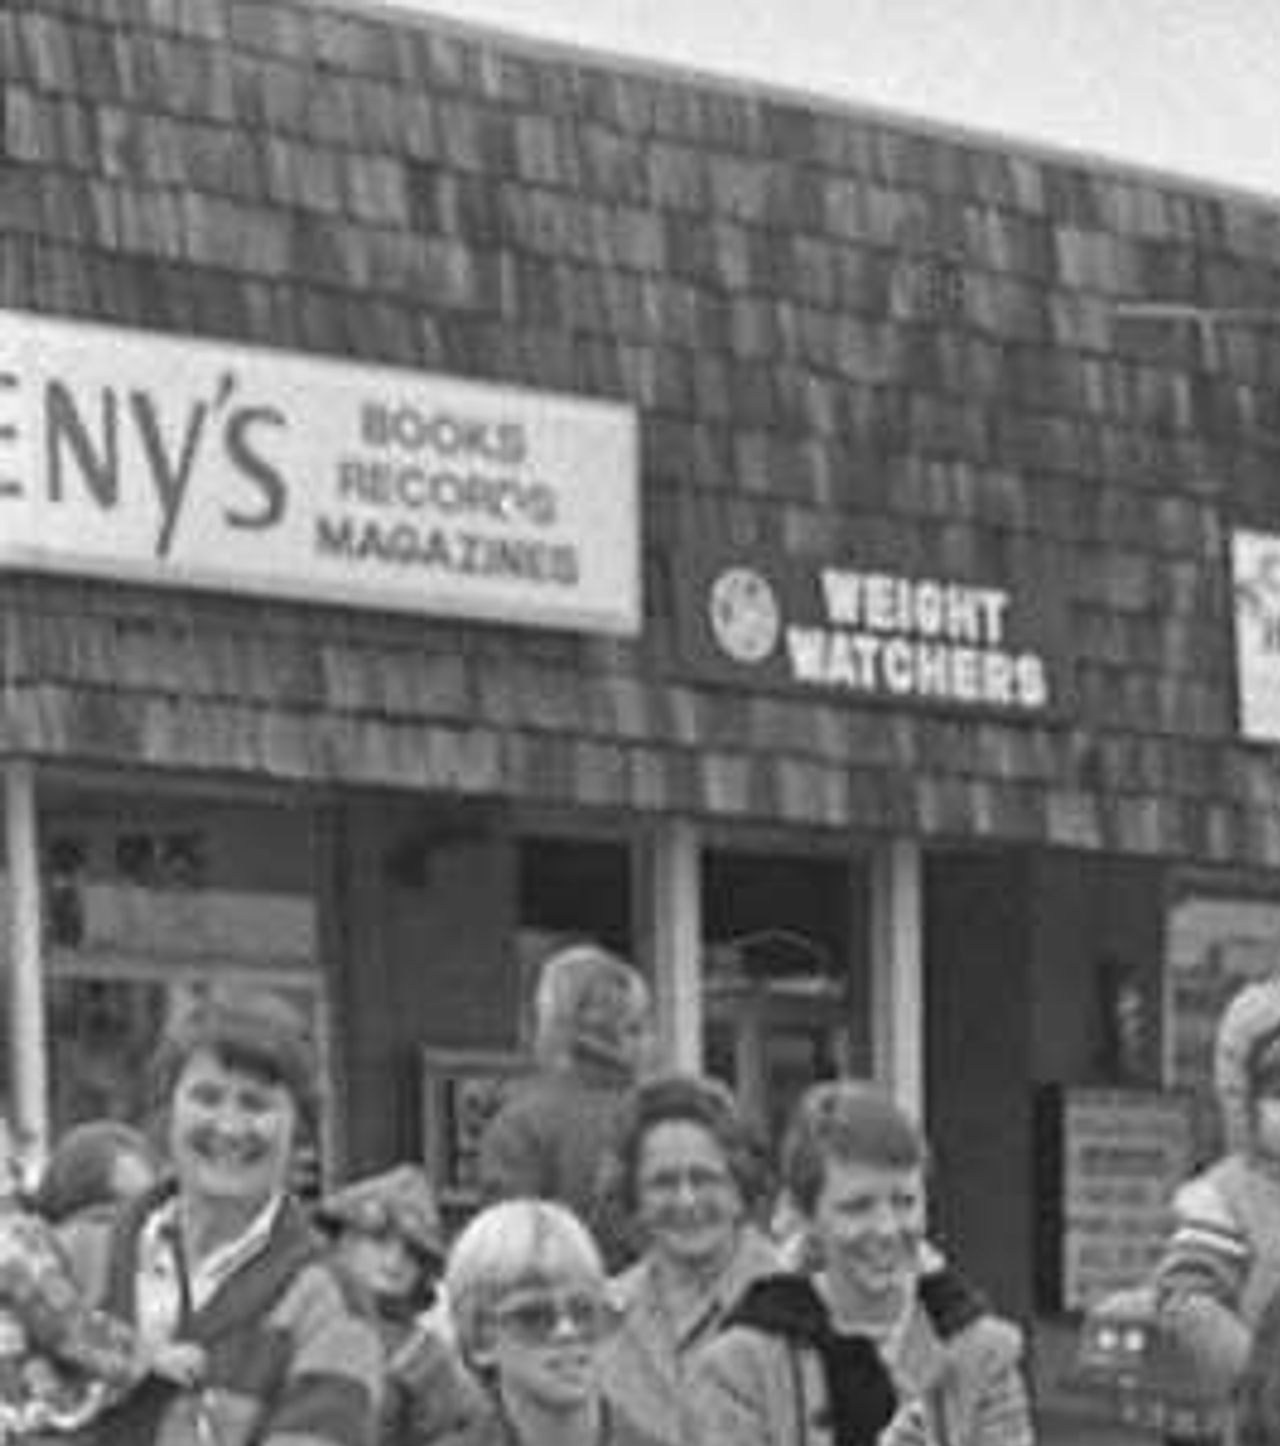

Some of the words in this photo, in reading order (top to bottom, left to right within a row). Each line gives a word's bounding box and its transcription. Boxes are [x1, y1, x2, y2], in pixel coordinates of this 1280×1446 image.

[360, 402, 526, 464] BOOKS
[338, 460, 556, 528] RECORDS
[316, 515, 579, 587] MAGAZINES
[821, 567, 1008, 643] WEIGHT
[786, 625, 1047, 708] WATCHERS
